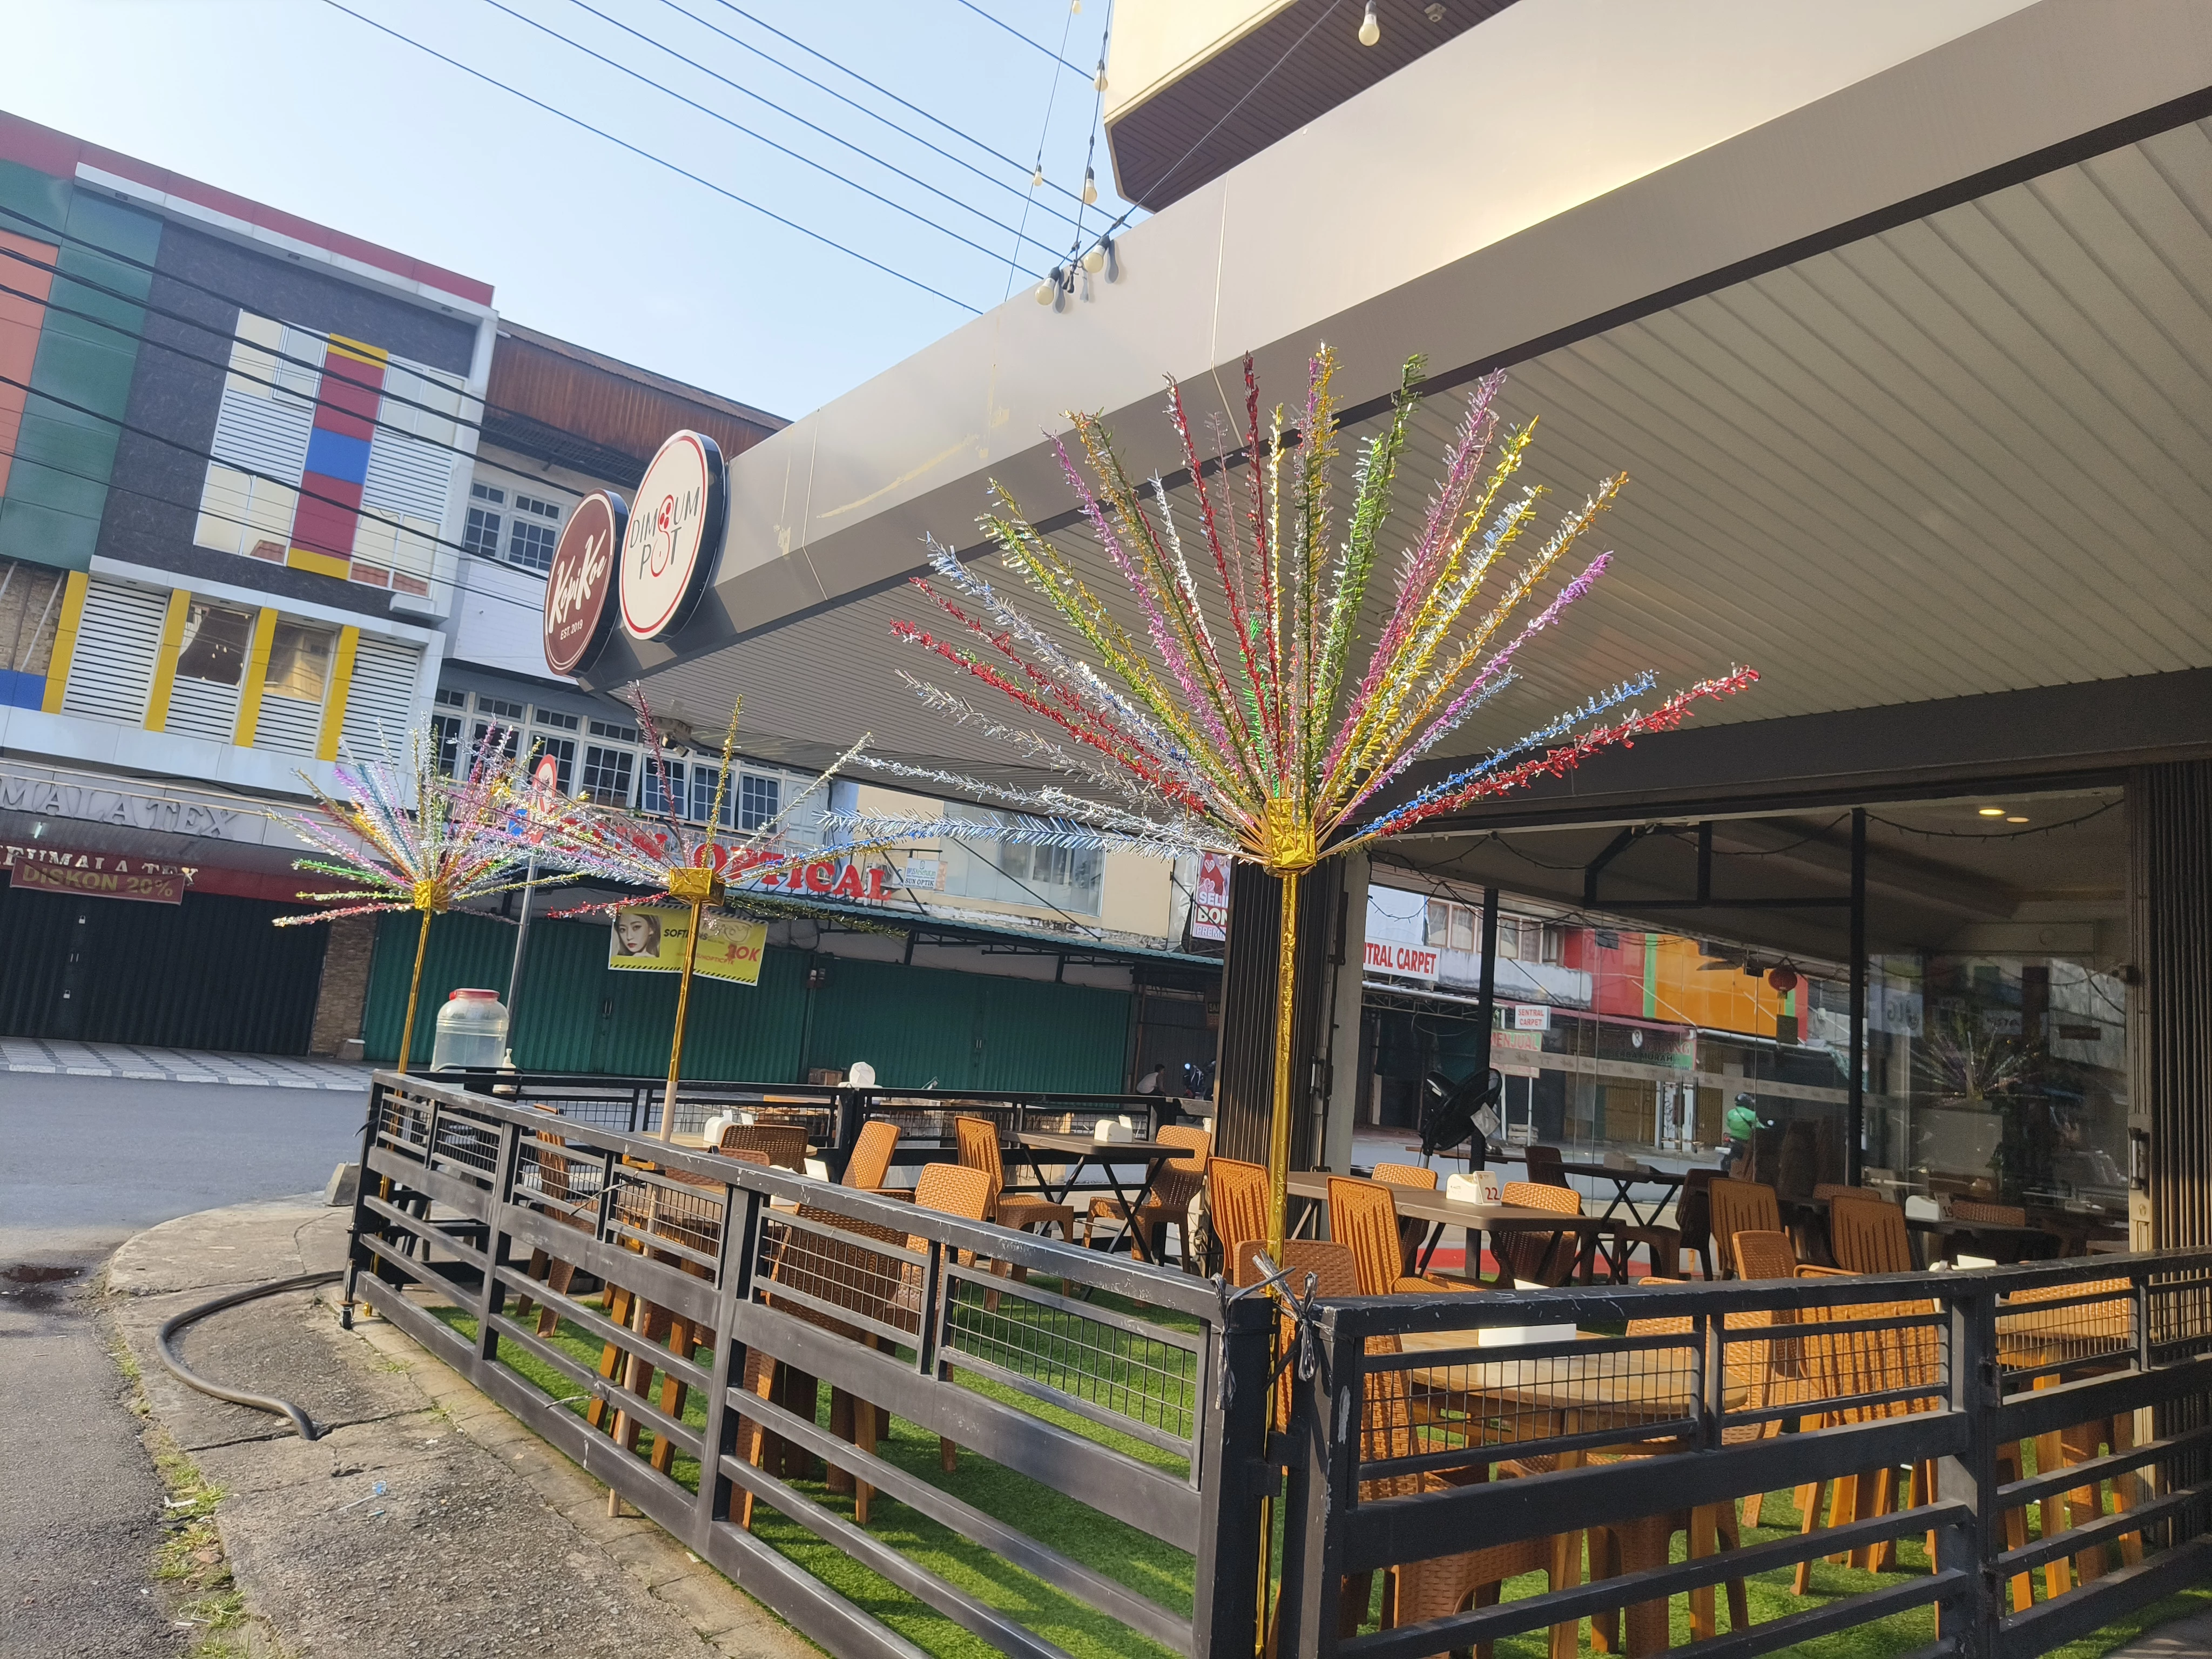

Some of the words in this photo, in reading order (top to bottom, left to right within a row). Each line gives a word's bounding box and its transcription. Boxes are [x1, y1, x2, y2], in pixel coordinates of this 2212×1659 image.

[571, 619, 583, 635] 2019
[127, 876, 173, 897] 20%
[1397, 948, 1437, 974] CARPET
[1485, 1187, 1500, 1200] 22
